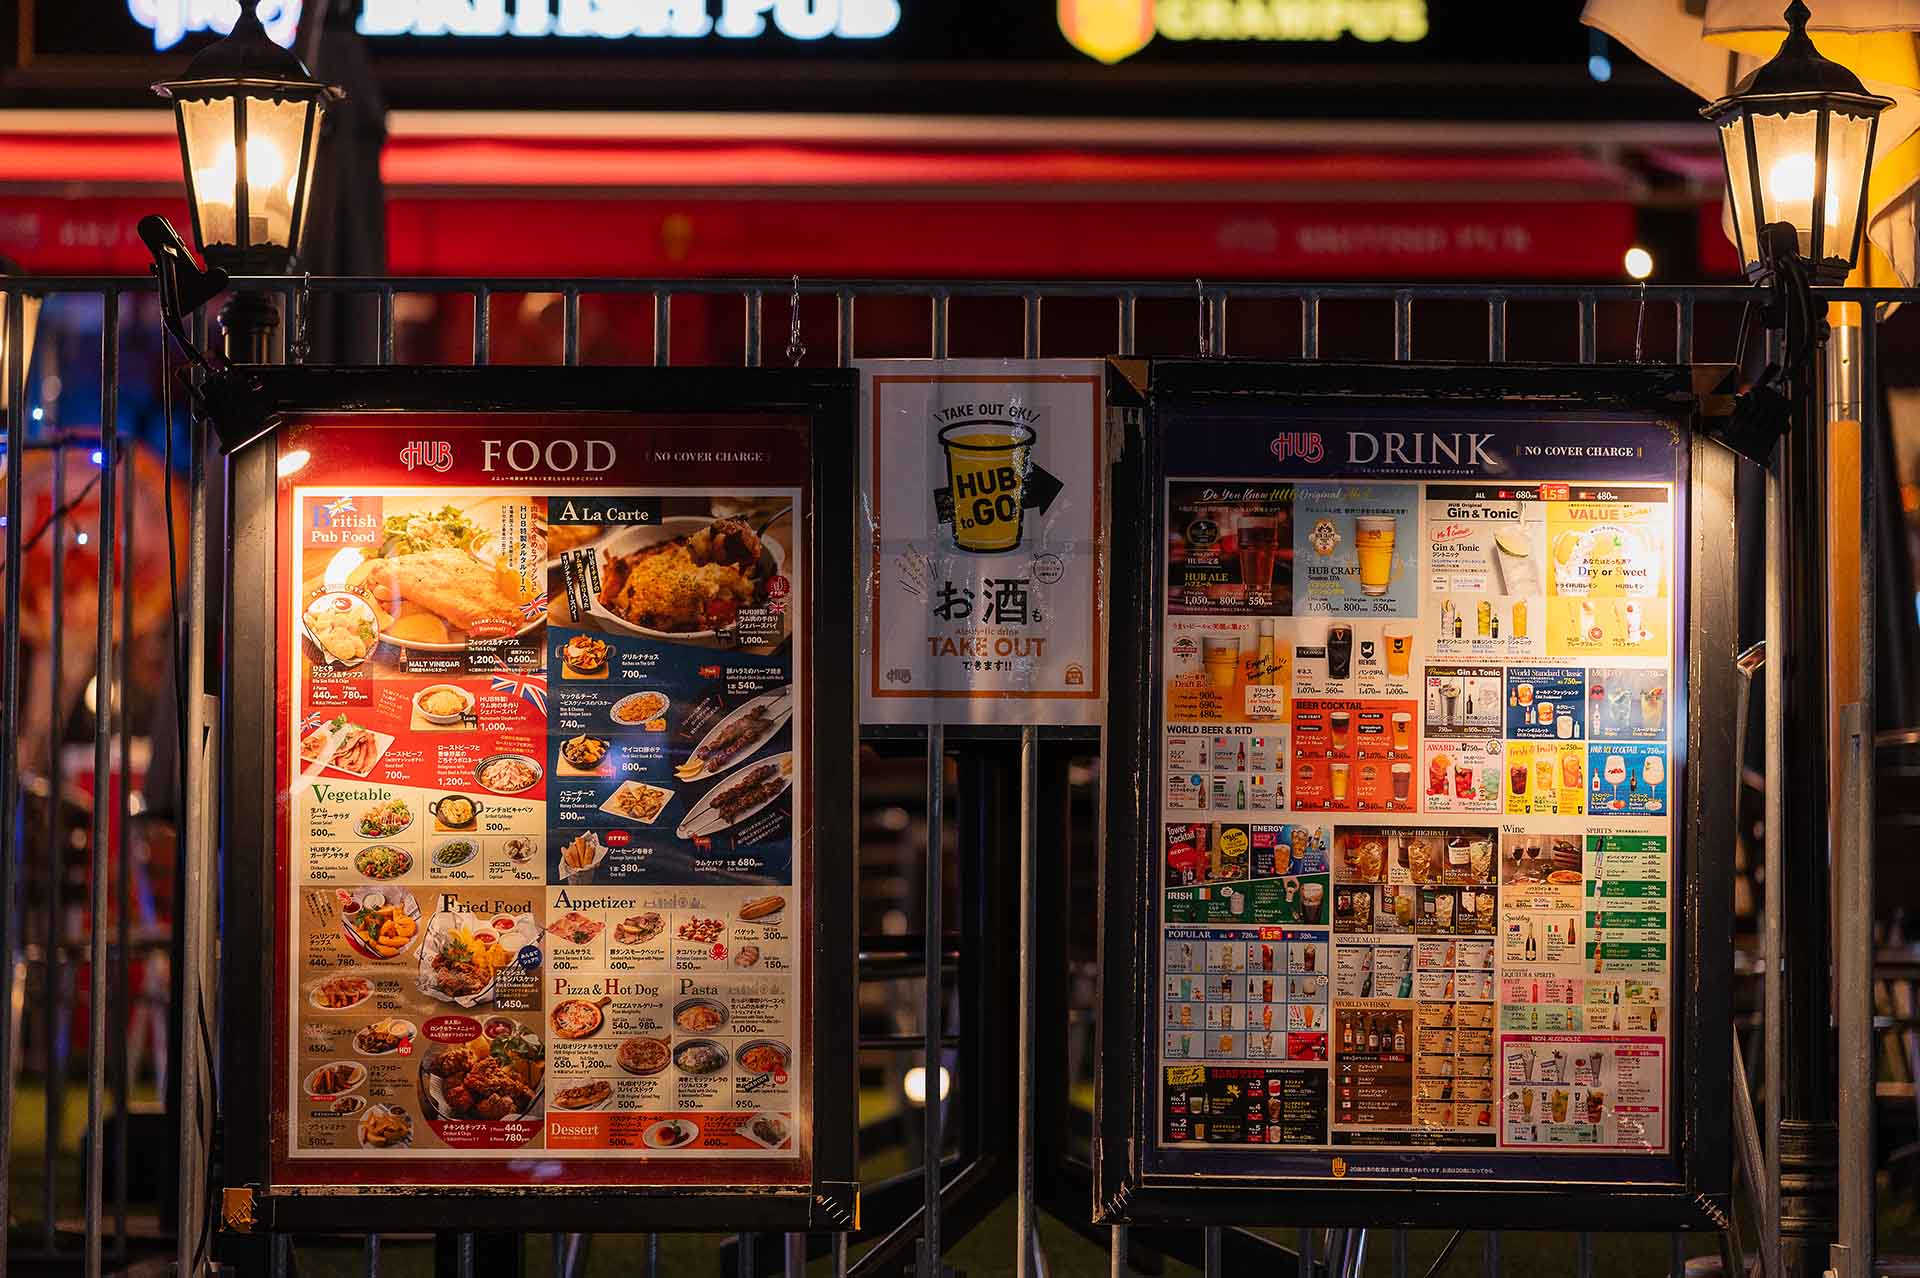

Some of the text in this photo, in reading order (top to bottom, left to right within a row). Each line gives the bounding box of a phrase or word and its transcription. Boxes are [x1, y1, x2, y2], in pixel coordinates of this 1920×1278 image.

[942, 404, 973, 420] TAKE
[979, 404, 1004, 415] OUT
[1270, 431, 1634, 465] HUB DRINK NO COVER CHARGE
[400, 439, 763, 472] HUB FOOD NO COVER CHARGE
[956, 467, 1017, 499] HUB
[1516, 491, 1537, 499] 680yen
[1596, 491, 1618, 500] 480yen
[560, 501, 649, 521] A La Carte
[961, 495, 1017, 529] to GO
[1447, 508, 1519, 519] Gin & Tonic
[1569, 509, 1619, 520] VALUE
[312, 505, 376, 528] British
[312, 531, 375, 543] Pub Food
[1432, 543, 1448, 552] Gin
[1457, 543, 1480, 552] Tonic
[1308, 567, 1362, 575] HUB CRAFT
[1578, 567, 1599, 578] Dry
[1184, 573, 1228, 582] HUB ALE
[934, 579, 1042, 625] お酒も
[1184, 596, 1273, 606] 1,050yen 800yen 550yen
[1343, 603, 1396, 612] 800yen 550yen
[928, 637, 1046, 657] TAKE OUT
[622, 670, 647, 679] 700yen
[1510, 669, 1583, 677] World Standard Classic
[738, 682, 763, 690] 540yen
[312, 691, 368, 699] 440yen 780yen
[1296, 702, 1363, 710] BEER COCKTAIL
[479, 722, 513, 731] 1,000yen
[560, 720, 585, 729] 740yen
[1167, 726, 1252, 734] WORLD BEER & RTD
[1426, 744, 1455, 752] AWARD
[622, 763, 647, 772] 800yen
[385, 771, 410, 780] 700yen
[438, 778, 471, 787] 1,200yen
[312, 784, 391, 803] Vegetable
[560, 812, 585, 821] 500yen
[486, 823, 511, 832] 500yen
[1503, 824, 1525, 833] Wine
[311, 829, 336, 837] 500yen
[738, 859, 764, 867] 680yen
[621, 864, 645, 873] 380yen
[310, 872, 336, 880] 680yen
[449, 871, 474, 880] 400yen
[514, 872, 540, 881] 450yen
[553, 889, 636, 911] Appetizer
[1168, 892, 1192, 900] IRISH
[441, 894, 531, 913] Fried Food
[763, 932, 788, 940] 300yen
[1168, 931, 1211, 939] POPULAR
[553, 962, 578, 970] 600yen
[610, 962, 635, 970] 600yen
[676, 962, 701, 970] 550yen
[764, 961, 789, 969] 150yen
[554, 978, 658, 997] Pizza & Hot Dog
[680, 978, 718, 995] Pasta
[496, 1000, 529, 1009] 1,450yen
[612, 1022, 663, 1030] 540yen 980yen
[731, 1025, 765, 1033] 1,000yen
[553, 1060, 612, 1069] 650yen 1,200yen
[1171, 1093, 1186, 1102] No.1
[618, 1101, 643, 1109] 500yen
[678, 1100, 703, 1109] 950yen
[735, 1100, 761, 1109] 950yen
[1170, 1119, 1187, 1128] No.2
[504, 1124, 530, 1133] 440yen
[551, 1122, 599, 1136] Dessert
[504, 1134, 530, 1142] 780yen
